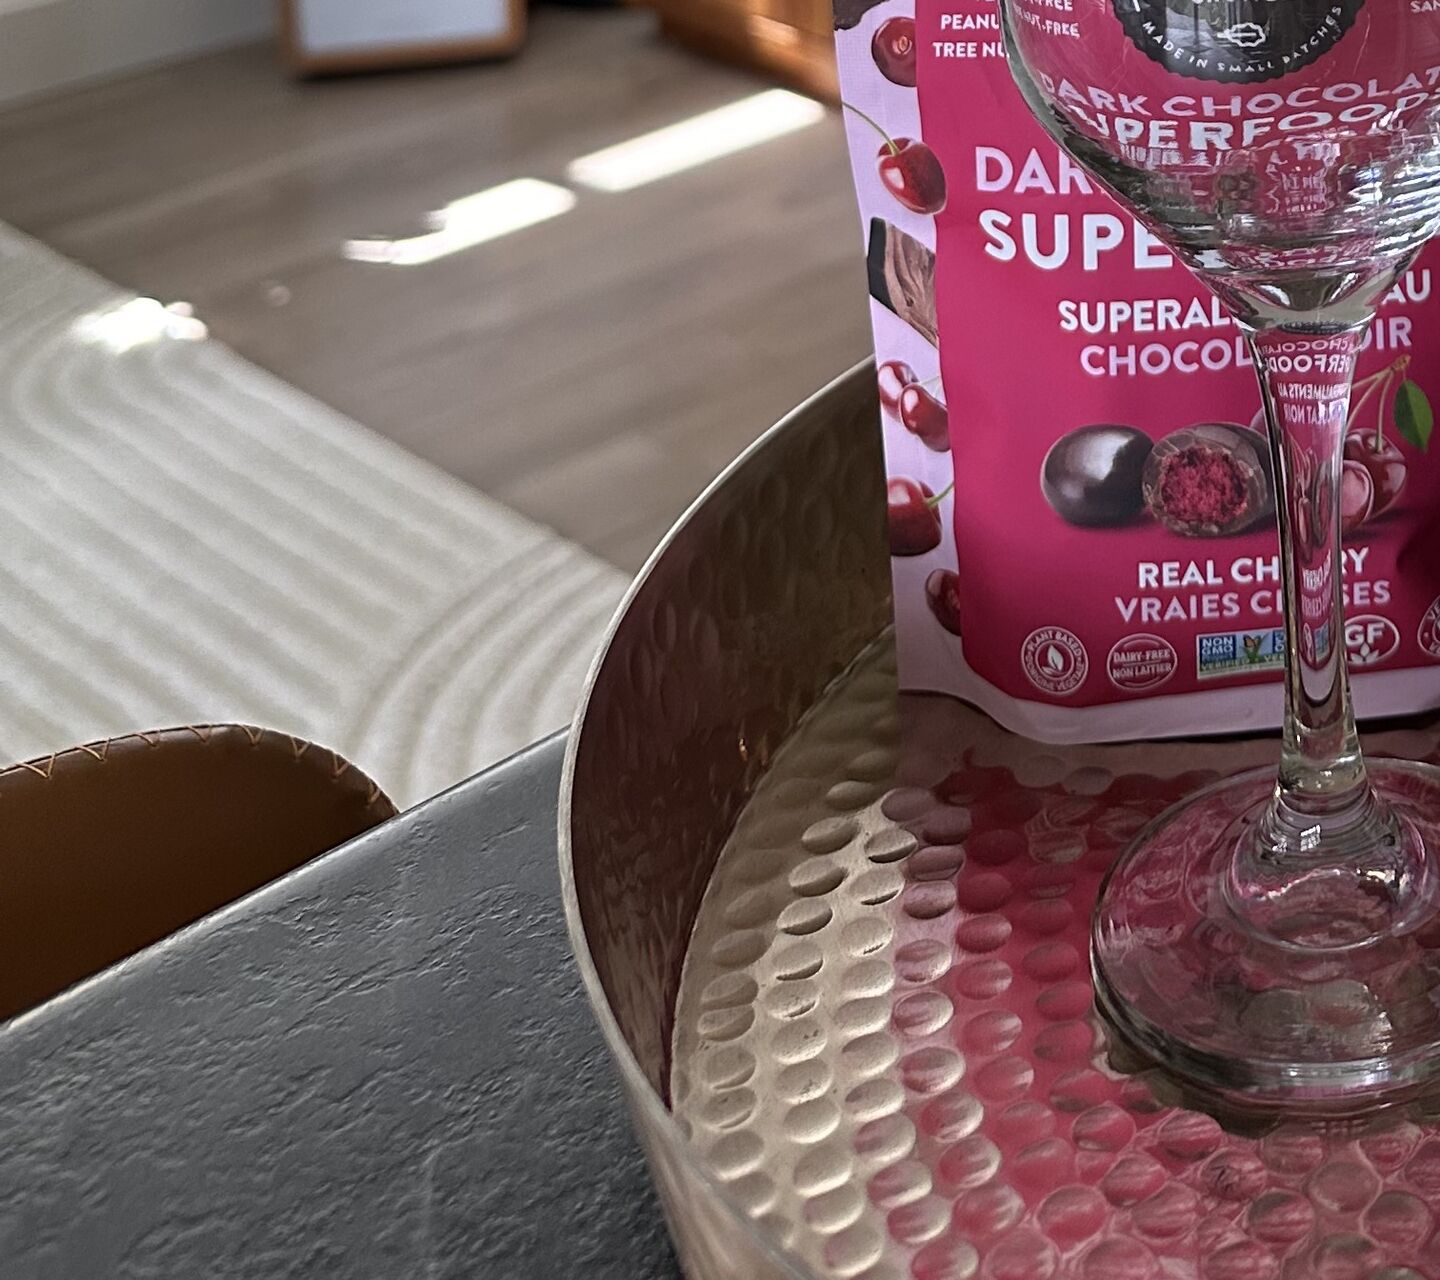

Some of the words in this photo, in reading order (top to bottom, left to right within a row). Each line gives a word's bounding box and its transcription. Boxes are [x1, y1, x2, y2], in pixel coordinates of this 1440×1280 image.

[932, 42, 977, 58] TREE
[1142, 20, 1184, 60] MADE
[1189, 54, 1209, 69] IN
[1058, 298, 1237, 334] SUPERAL
[1079, 342, 1252, 377] CHOCOL
[1137, 559, 1223, 590] REAL
[1114, 592, 1242, 623] VRAIES
[1055, 631, 1082, 657] BASED
[1202, 636, 1233, 648] NON
[1345, 620, 1386, 646] GF
[1113, 648, 1171, 663] DAIRY-FREE
[1202, 645, 1233, 656] GMO
[1112, 667, 1134, 679] NON
